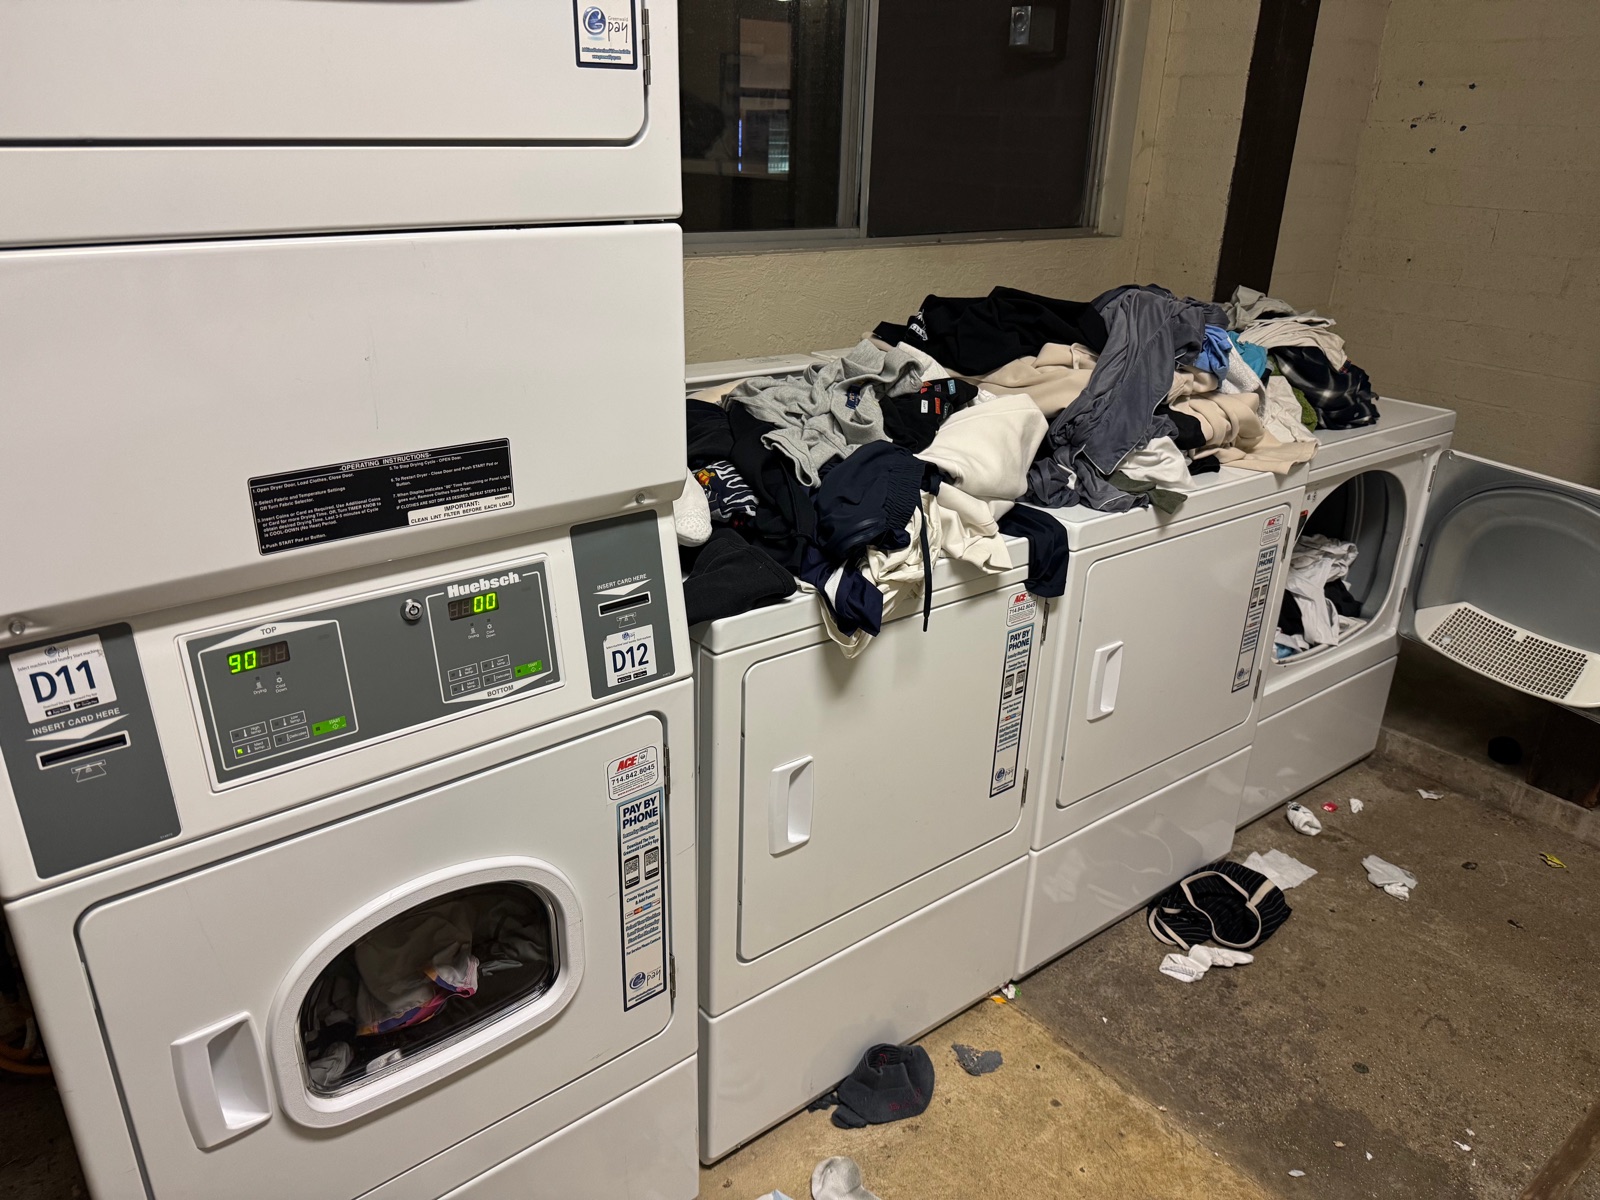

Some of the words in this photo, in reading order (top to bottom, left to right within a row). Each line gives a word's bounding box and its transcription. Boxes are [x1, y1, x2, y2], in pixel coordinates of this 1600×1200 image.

[608, 22, 628, 43] pay
[410, 516, 428, 524] CLEAN
[443, 510, 460, 518] FILTER
[463, 505, 481, 514] BEFORE
[444, 501, 480, 511] IMPORTANT:
[1259, 558, 1273, 567] PHONE
[447, 572, 520, 598] Huebsch
[597, 581, 616, 591] INSERT
[617, 577, 632, 585] CARD
[633, 573, 647, 581] HERE
[473, 592, 496, 613] 00
[1014, 593, 1027, 604] ACE
[260, 626, 277, 635] TOP
[1010, 632, 1021, 643] PAY
[1022, 629, 1030, 639] BY
[1008, 638, 1030, 652] PHONE
[57, 654, 72, 662] laundry
[228, 650, 256, 673] 90
[611, 641, 649, 674] D12
[28, 659, 96, 704] D11
[487, 685, 514, 697] BOTTOM
[32, 721, 65, 736] INSERT
[68, 714, 94, 727] CARD
[96, 707, 120, 719] HERE
[617, 755, 638, 772] ACE
[623, 802, 642, 818] PAY
[644, 796, 657, 809] BY
[623, 806, 658, 829] PHONE
[646, 967, 661, 987] pay
